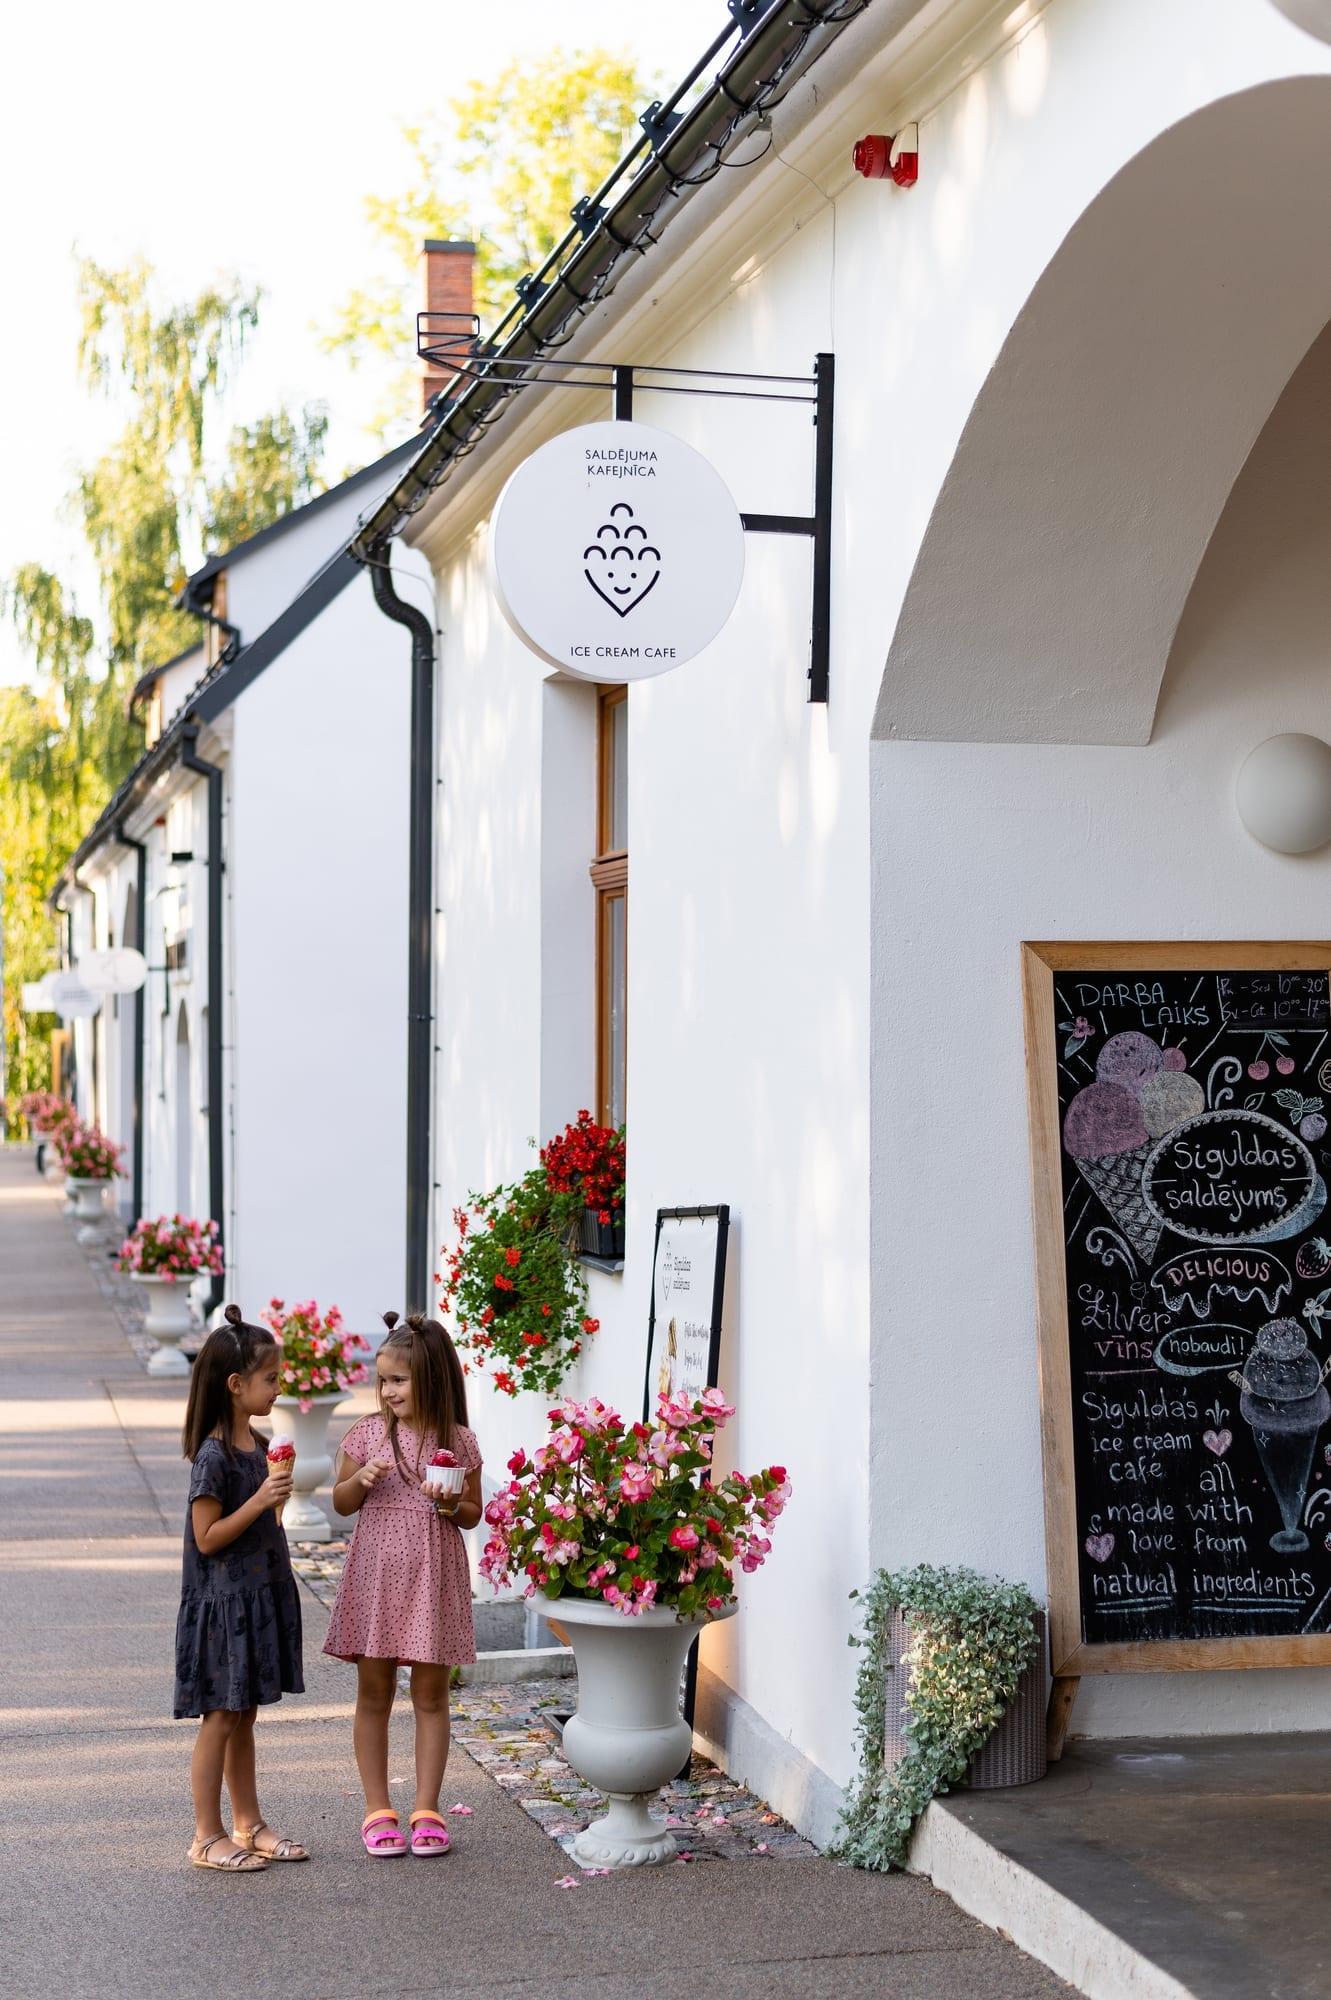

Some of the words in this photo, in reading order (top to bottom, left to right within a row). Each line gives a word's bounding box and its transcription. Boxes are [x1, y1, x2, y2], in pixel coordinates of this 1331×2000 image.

[585, 448, 658, 462] SALDĒJUMA
[587, 464, 656, 479] KAFEJNĪCA
[570, 646, 591, 657] ICE
[595, 647, 640, 658] CREAM
[644, 647, 676, 658] CAFE
[1075, 983, 1165, 1006] DARBA
[1174, 1130, 1298, 1178] Siguldas
[1166, 1178, 1288, 1222] saldējums
[1167, 1257, 1271, 1286] DELICIOUS
[1093, 1335, 1153, 1360] vīns
[1169, 1337, 1245, 1356] nobaudi!
[1082, 1387, 1199, 1429] Sigulda's
[1092, 1433, 1124, 1452] ice
[1133, 1433, 1192, 1451] cream
[1108, 1453, 1163, 1484] café
[1200, 1461, 1235, 1492] all
[1107, 1497, 1175, 1524] made
[1185, 1496, 1253, 1524] with
[1128, 1529, 1177, 1554] love
[1193, 1528, 1248, 1555] from
[1093, 1562, 1178, 1597] natural
[1192, 1568, 1316, 1601] ingredients
